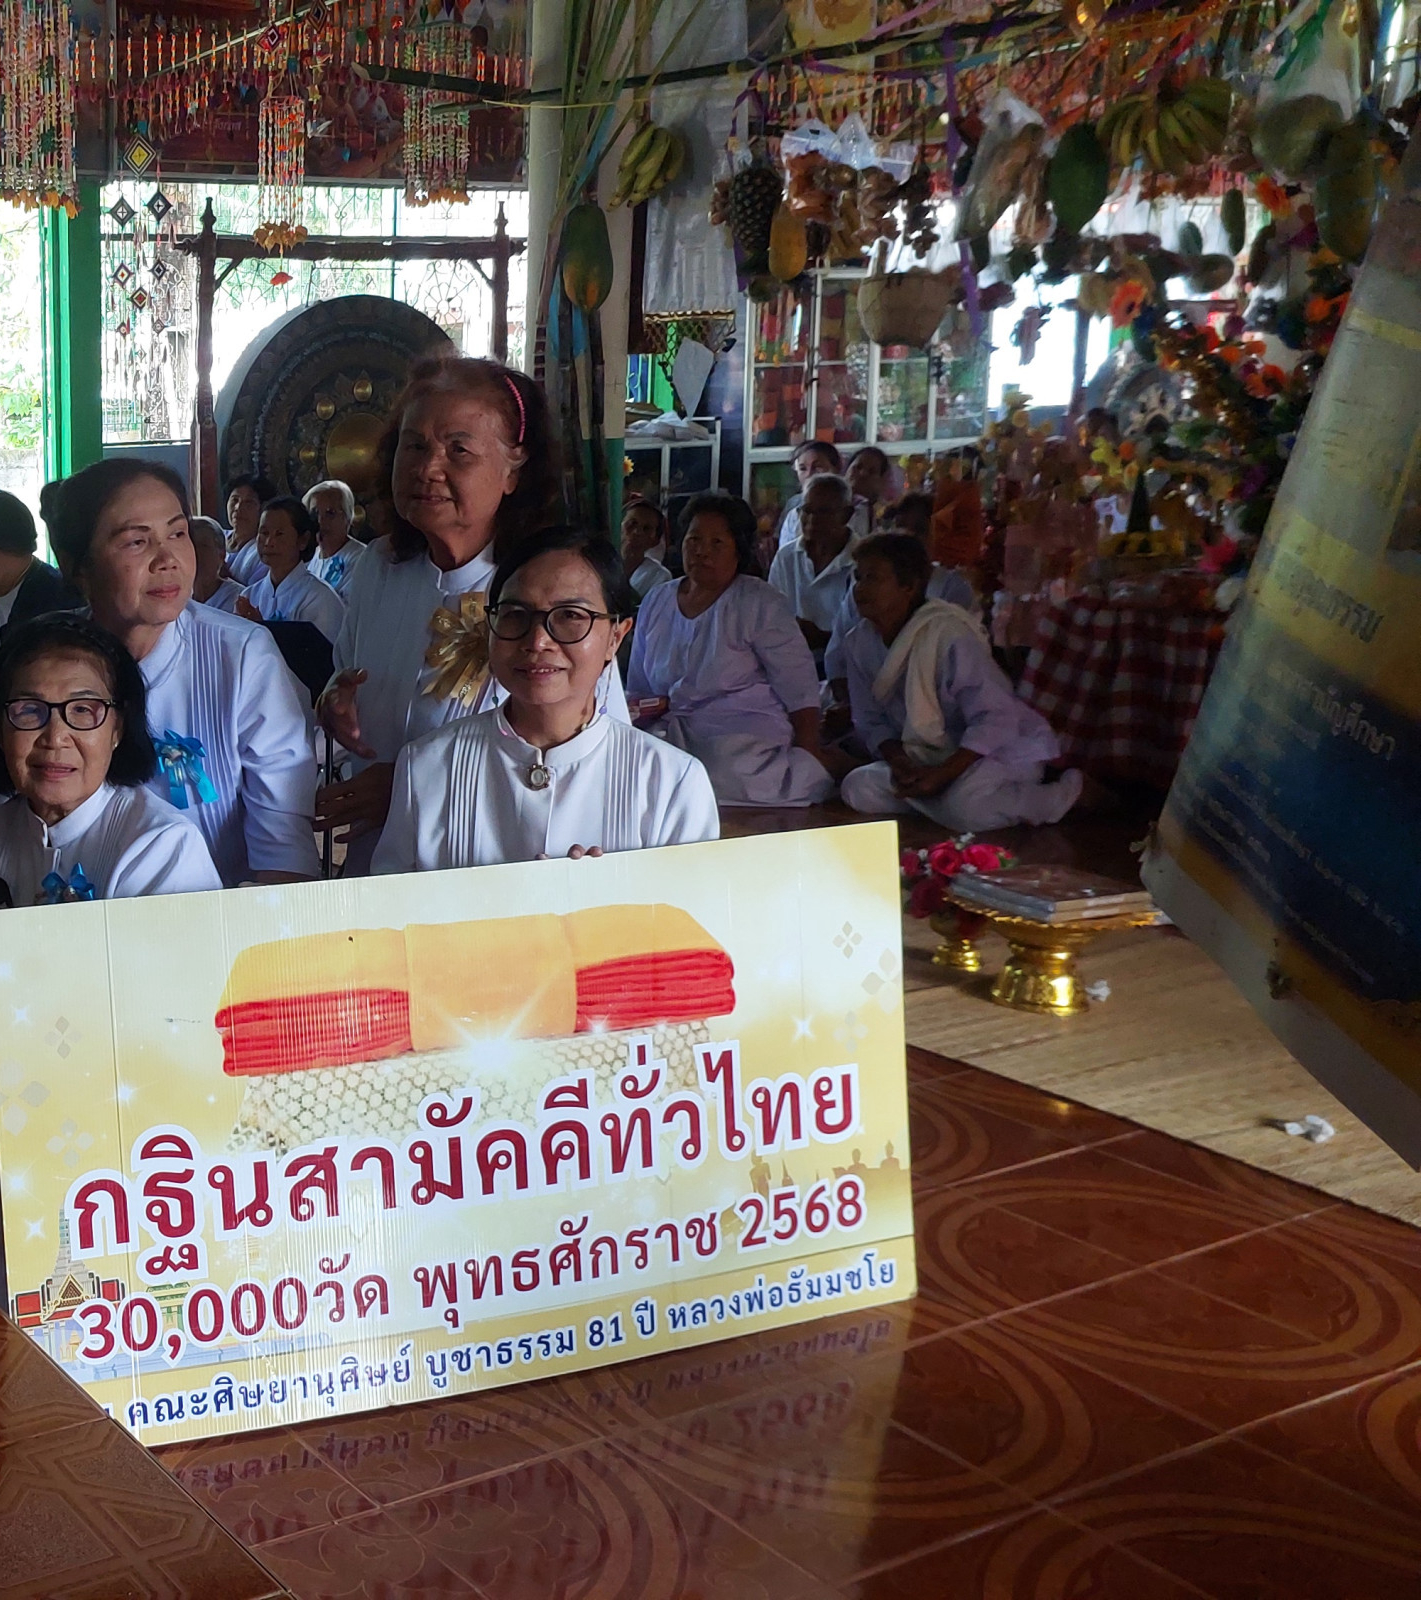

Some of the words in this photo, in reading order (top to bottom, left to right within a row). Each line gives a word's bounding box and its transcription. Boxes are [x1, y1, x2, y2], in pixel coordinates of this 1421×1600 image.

[73, 1045, 853, 1275] กฐินสามัคคีทั่วไทย
[79, 1253, 389, 1361] 30,000วัด
[413, 1215, 717, 1327] พุทธศักราช
[740, 1180, 863, 1247] 2568
[128, 1343, 412, 1427] คณะศิษยานุศิษย์
[426, 1328, 575, 1388] บูชาธรรม
[588, 1316, 624, 1347] 81
[635, 1303, 656, 1336] ปี
[667, 1253, 894, 1329] หลวงพ่อธัมมชโย
